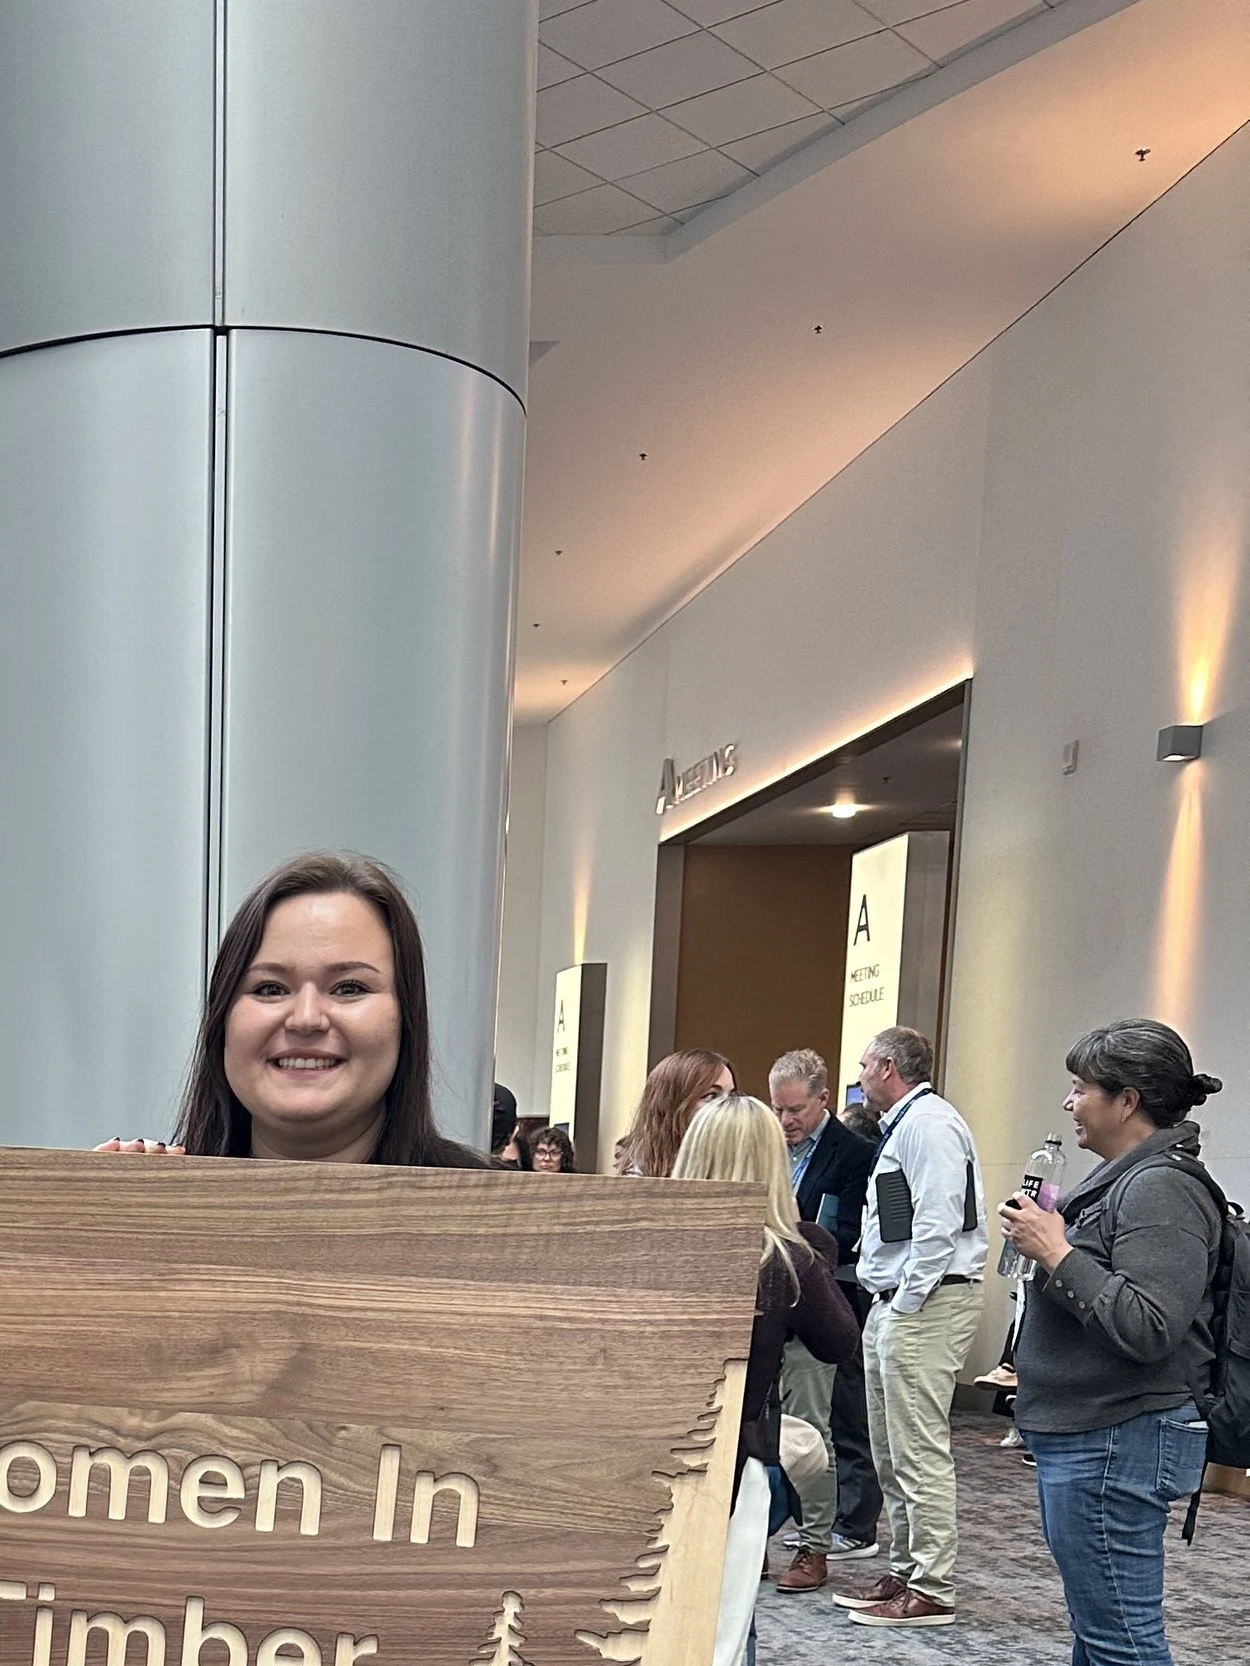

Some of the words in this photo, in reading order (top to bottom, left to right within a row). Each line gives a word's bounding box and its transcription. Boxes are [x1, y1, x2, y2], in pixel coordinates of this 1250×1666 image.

[656, 758, 675, 815] A
[674, 744, 736, 804] MEETING
[853, 894, 870, 946] A
[850, 963, 880, 983] MEETING
[557, 999, 565, 1032] A
[849, 986, 885, 1007] SCHEDULE
[371, 1443, 481, 1548] In
